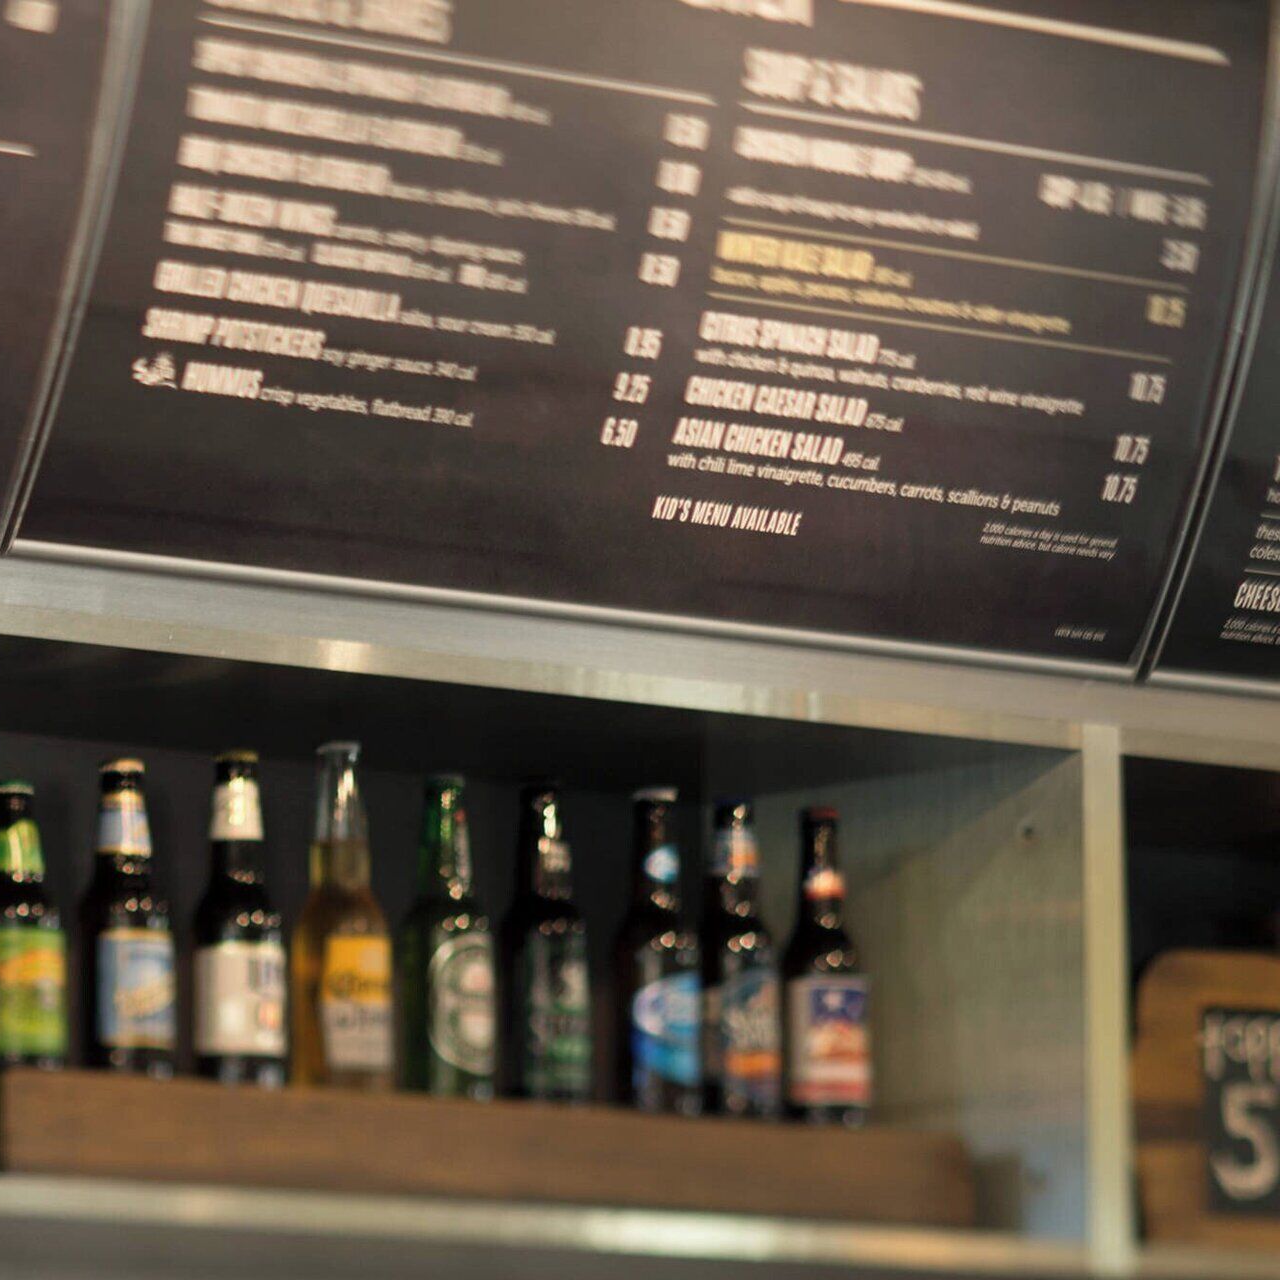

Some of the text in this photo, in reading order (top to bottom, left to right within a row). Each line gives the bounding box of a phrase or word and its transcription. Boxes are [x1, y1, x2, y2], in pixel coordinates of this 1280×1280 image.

[684, 375, 757, 412] CHICKEN
[752, 384, 817, 420] CAESAR
[814, 392, 868, 427] SALAD
[601, 416, 638, 449] 6.50
[671, 417, 726, 450] ASIAN
[724, 423, 793, 458] CHICKEN
[792, 432, 844, 465] SALAD
[1113, 433, 1151, 465] 10.75
[667, 453, 697, 469] with
[697, 456, 725, 474] chili
[727, 459, 755, 478] lime
[900, 483, 944, 503] carrots,
[947, 488, 1000, 510] scallions
[1011, 498, 1062, 517] peanuts
[1100, 472, 1138, 504] 10.75
[651, 495, 803, 536] KID'S MENU AVAILABLE
